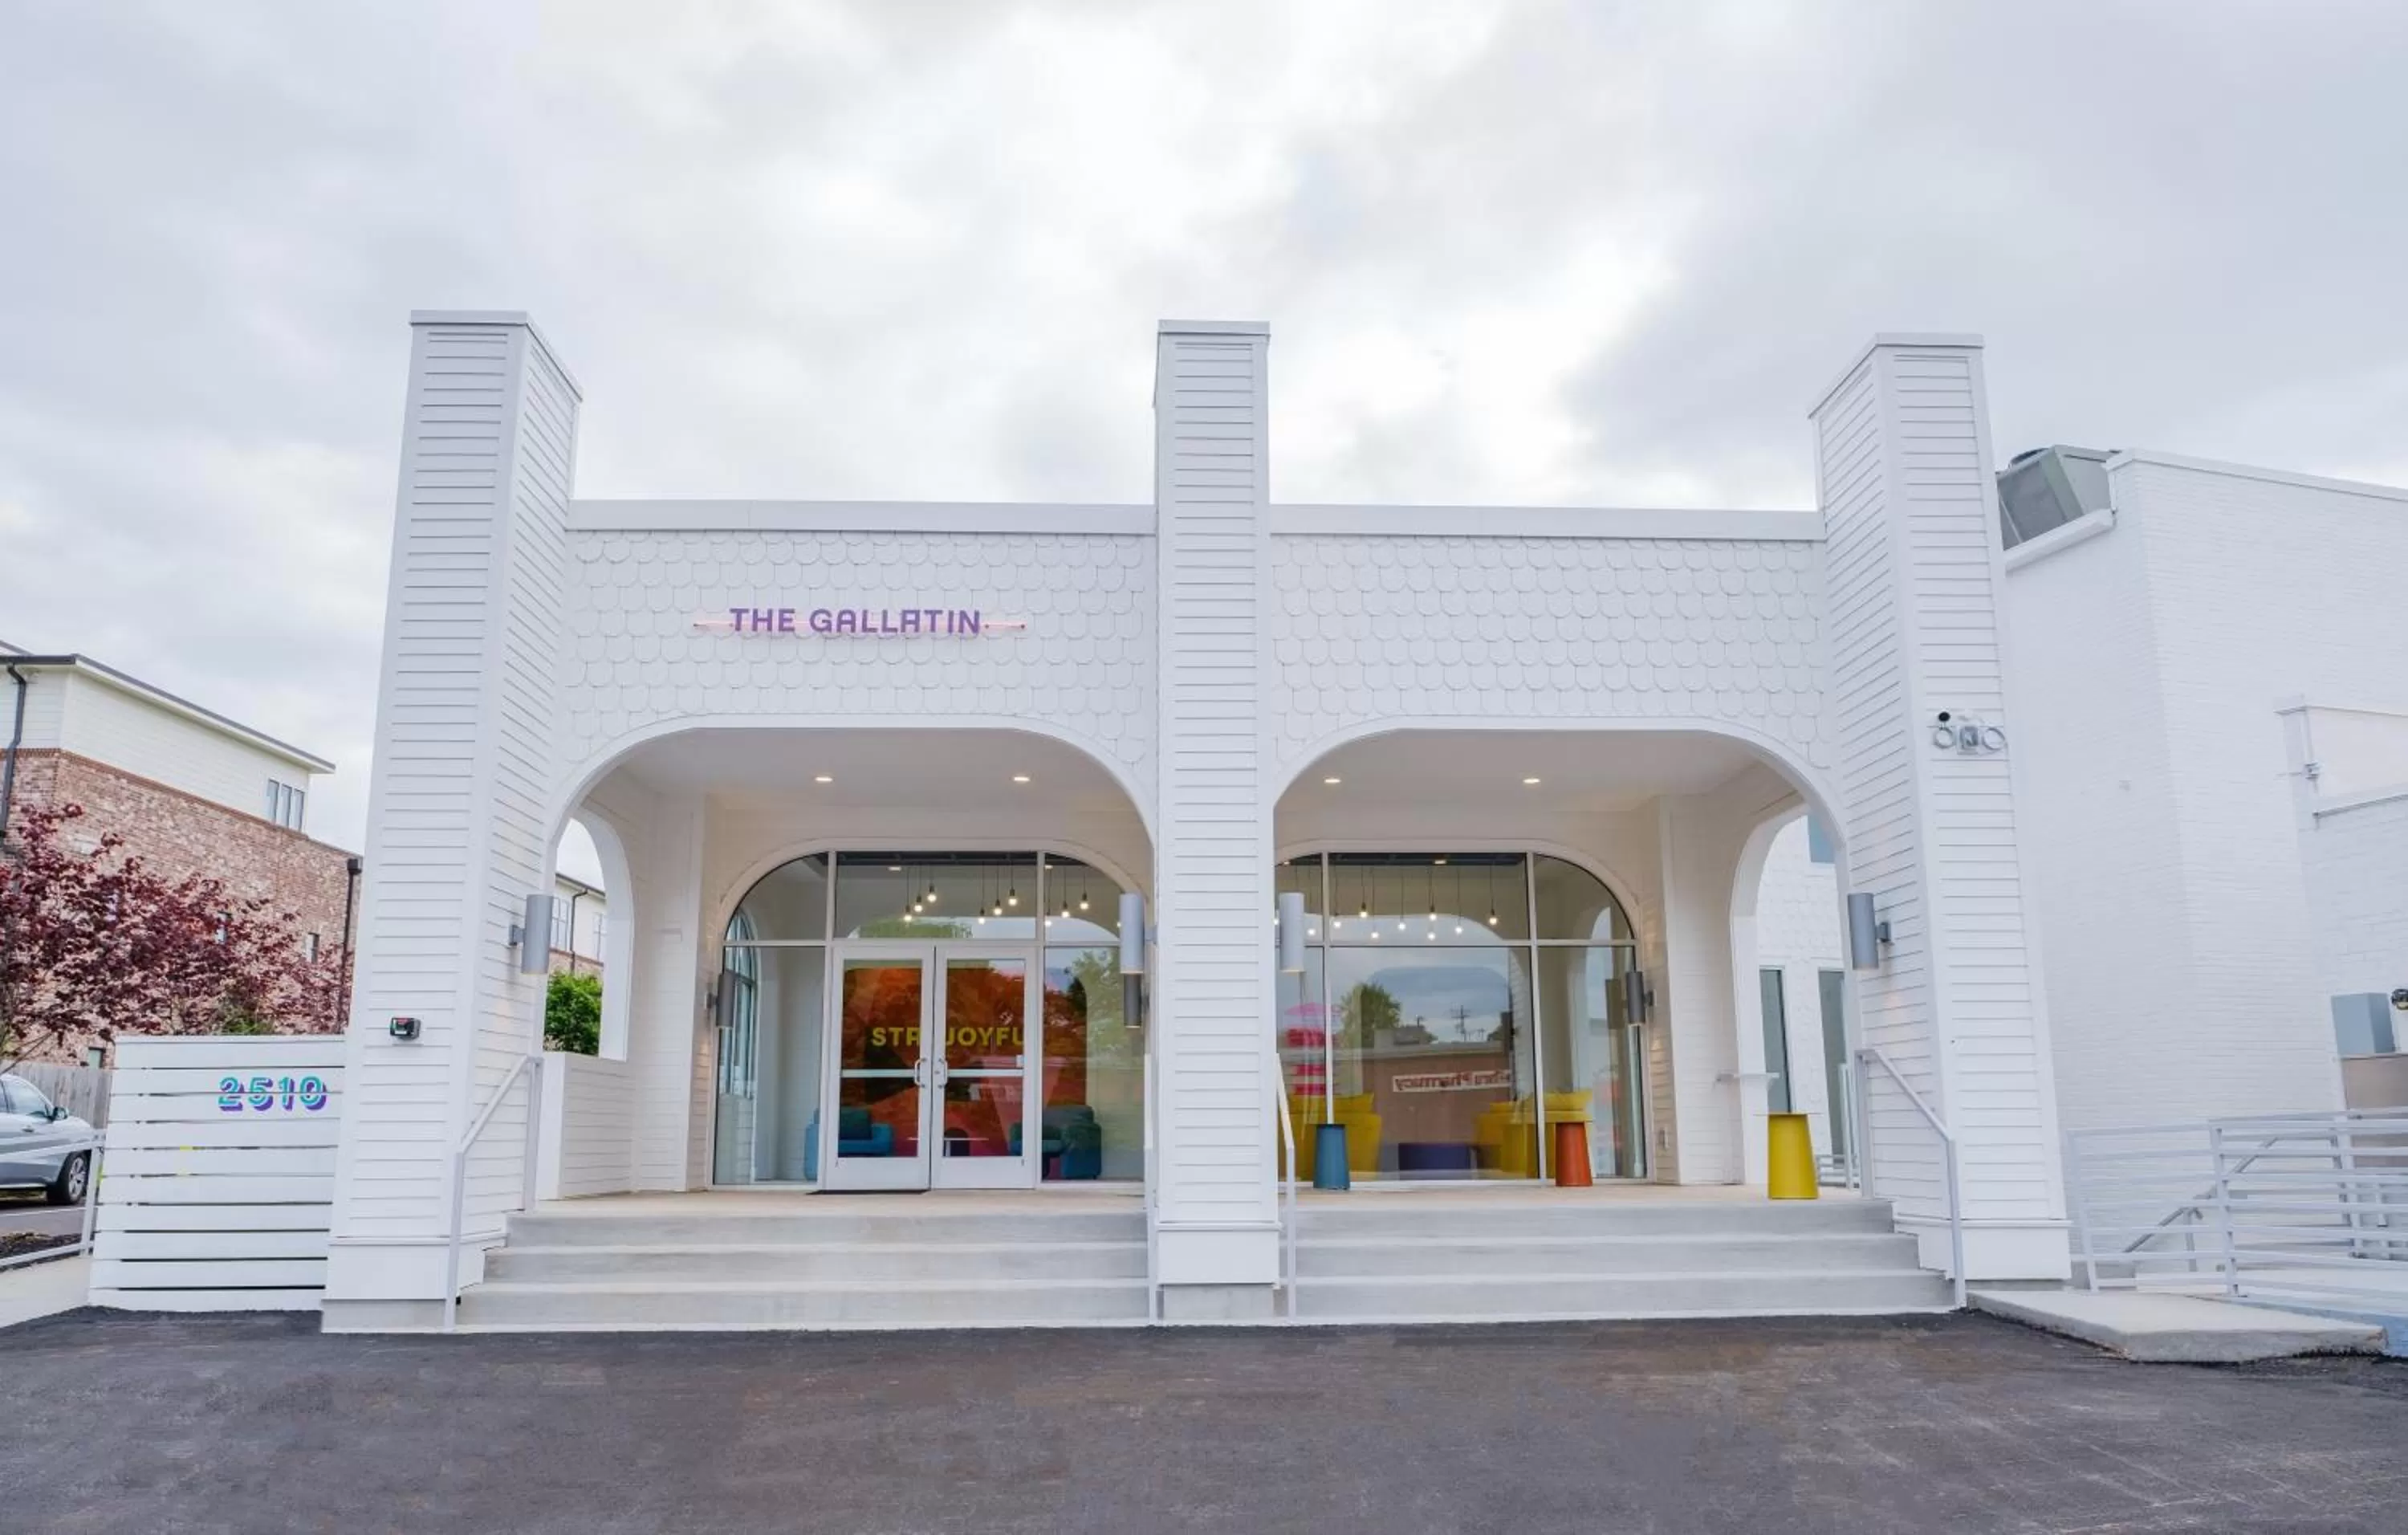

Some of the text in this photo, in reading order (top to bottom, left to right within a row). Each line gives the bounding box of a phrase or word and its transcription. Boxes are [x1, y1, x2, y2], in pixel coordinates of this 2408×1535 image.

[730, 609, 980, 634] THE GALLATIN
[946, 1027, 1024, 1046] JOYFU
[218, 1076, 328, 1112] 2510
